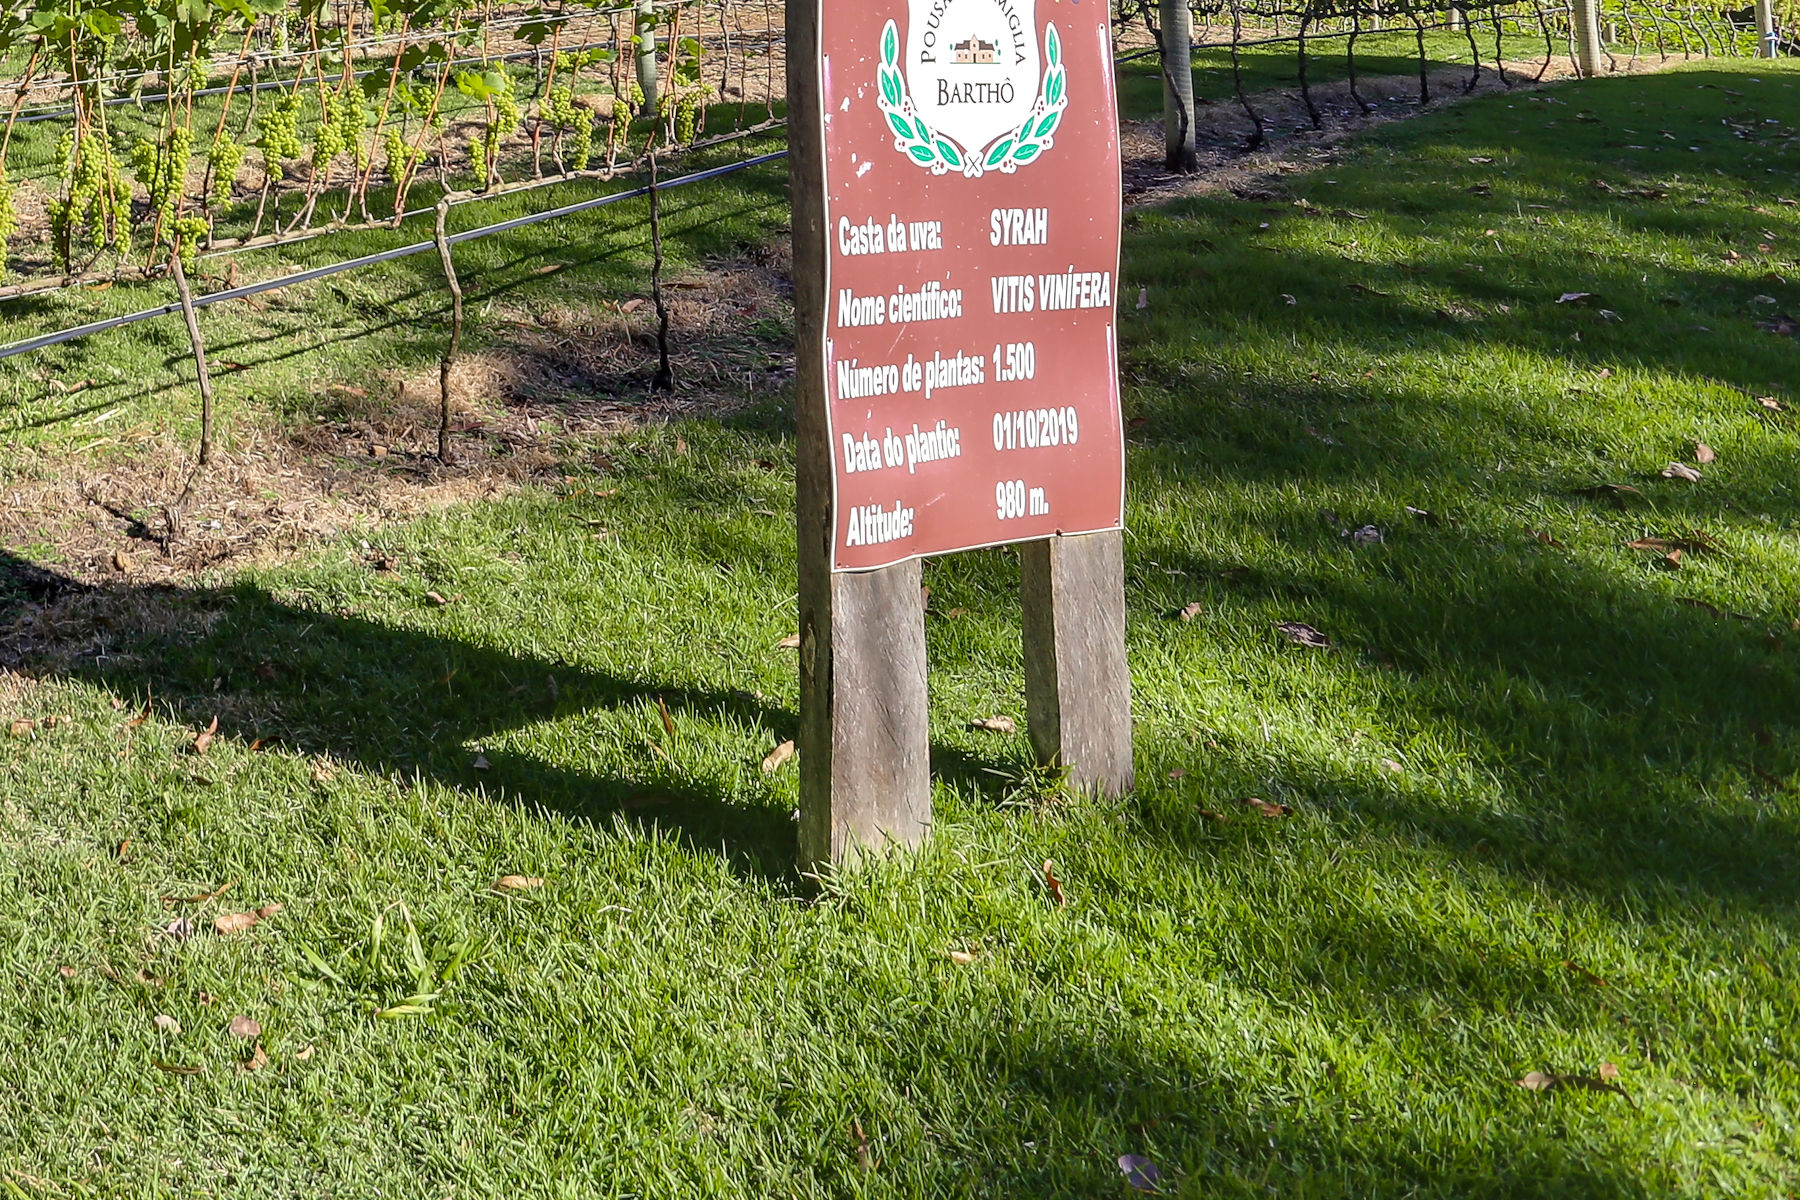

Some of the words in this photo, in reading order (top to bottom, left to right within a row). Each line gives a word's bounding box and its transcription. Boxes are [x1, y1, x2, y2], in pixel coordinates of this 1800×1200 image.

[838, 215, 885, 256] Casta
[886, 213, 907, 251] da
[909, 220, 942, 250] uva:
[990, 207, 1049, 247] SYRAH
[837, 288, 885, 327] Nome
[888, 280, 962, 323] científico:
[991, 275, 1035, 313] VITIS
[1038, 264, 1111, 311] VINÍFERA
[837, 358, 898, 400] Número
[902, 353, 922, 392] de
[925, 349, 985, 399] plantas:
[992, 342, 1035, 382] 1.500
[842, 432, 882, 474] Data
[885, 427, 904, 469] do
[905, 420, 961, 474] plantio:
[992, 406, 1078, 450] 01/10/2019
[846, 500, 914, 547] Altitude:
[995, 480, 1026, 519] 980
[1029, 484, 1049, 516] m.
